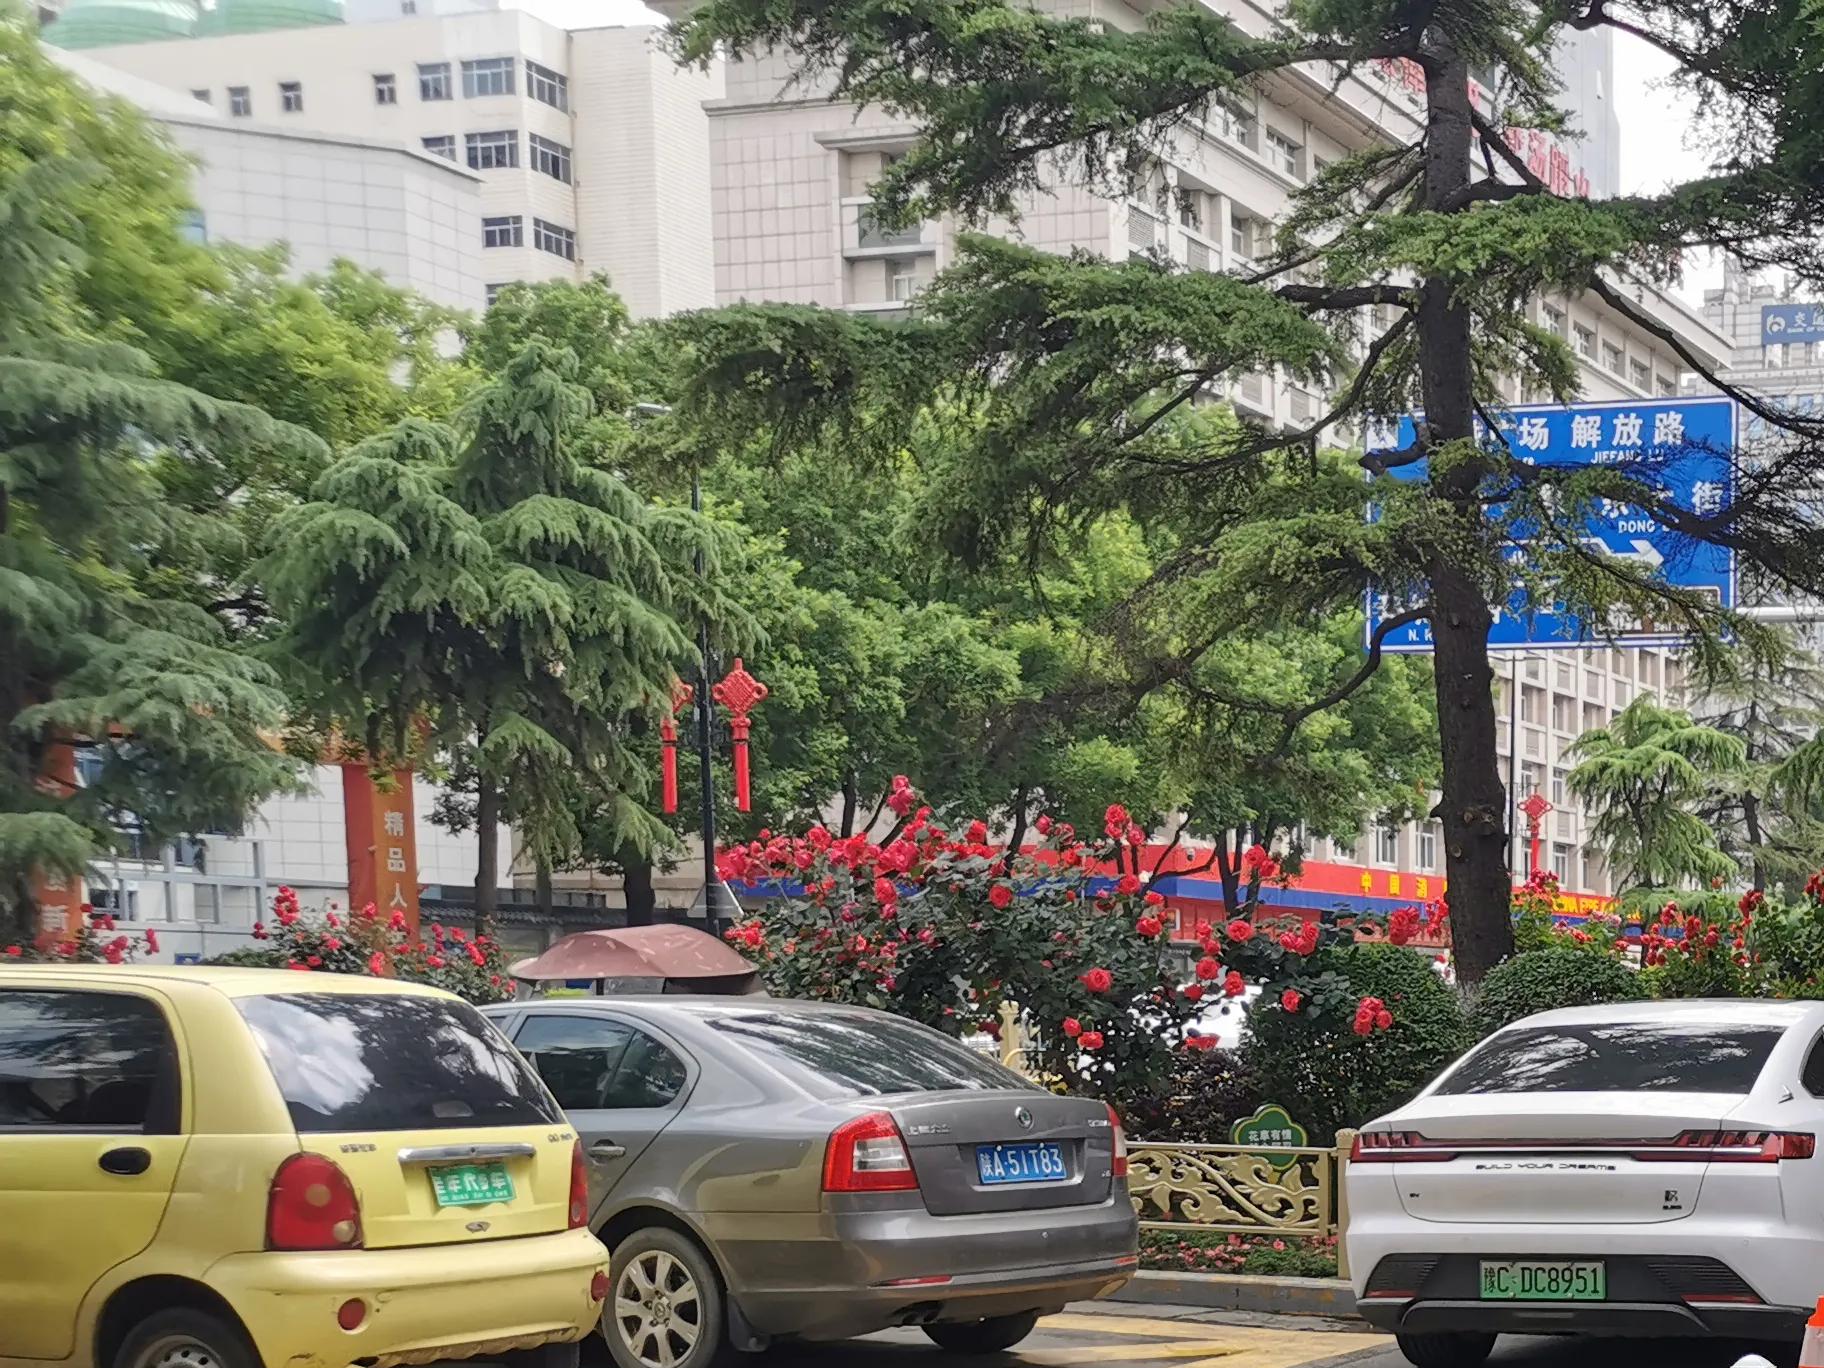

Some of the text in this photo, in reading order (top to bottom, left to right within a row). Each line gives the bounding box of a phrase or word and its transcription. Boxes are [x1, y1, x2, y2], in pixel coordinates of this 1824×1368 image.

[1570, 411, 1685, 449] 解放路
[1618, 519, 1656, 534] DONG
[1361, 871, 1447, 898] 中国消
